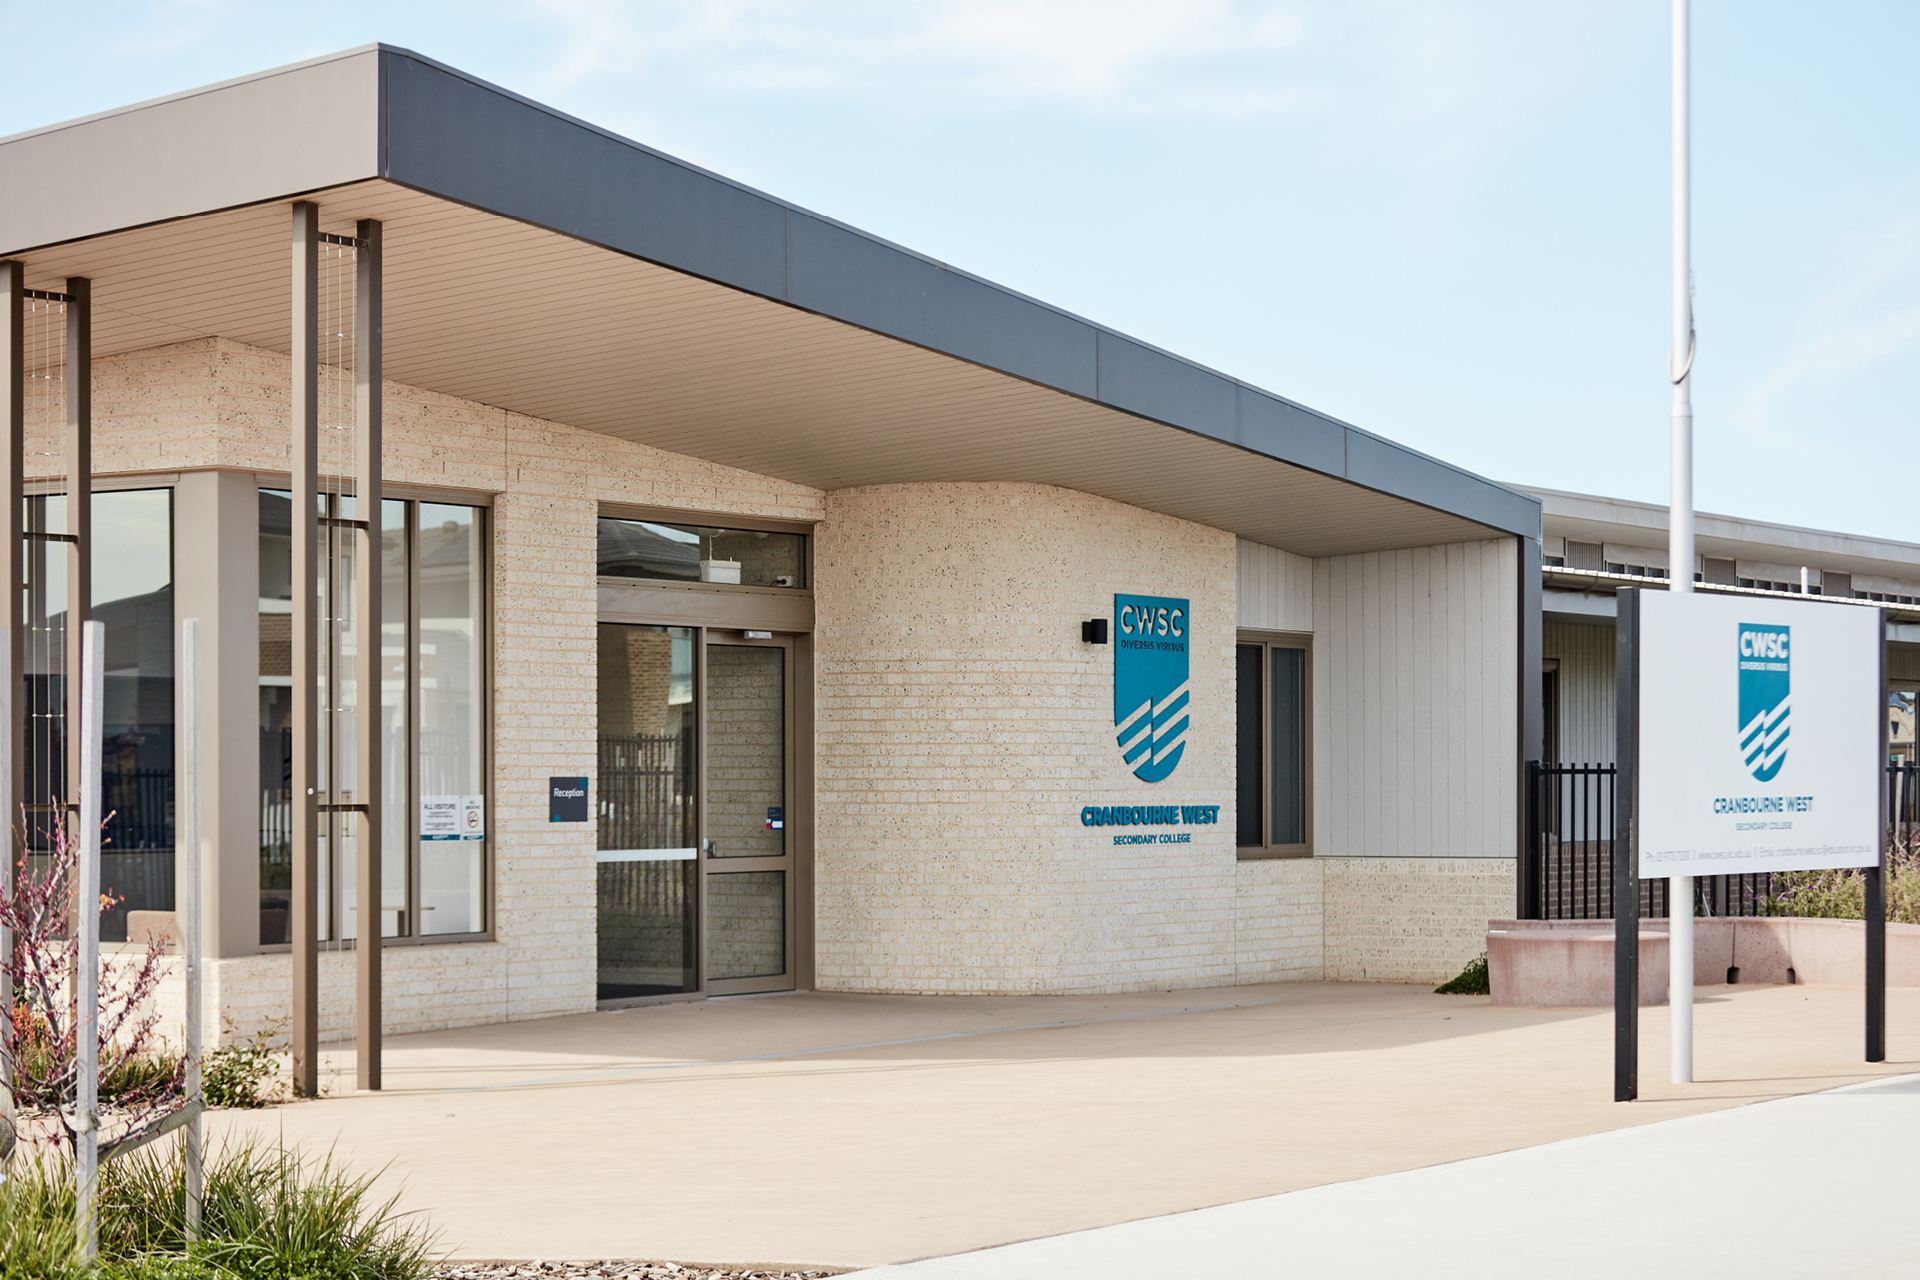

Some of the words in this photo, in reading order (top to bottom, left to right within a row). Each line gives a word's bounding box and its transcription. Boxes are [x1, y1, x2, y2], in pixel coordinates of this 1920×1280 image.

[1121, 604, 1184, 637] CWSC
[1121, 640, 1154, 650] DIVERSIS
[1156, 641, 1184, 652] VIRIBUS
[1740, 631, 1788, 658] CWSC
[553, 787, 584, 799] Reception
[1713, 797, 1783, 813] CRANBOURNE
[1786, 796, 1813, 812] WEST
[1081, 805, 1180, 826] CRANBOURNE
[1180, 805, 1220, 825] WEST
[1113, 835, 1157, 845] SECONDARY
[1159, 833, 1191, 843] COLLEGE
